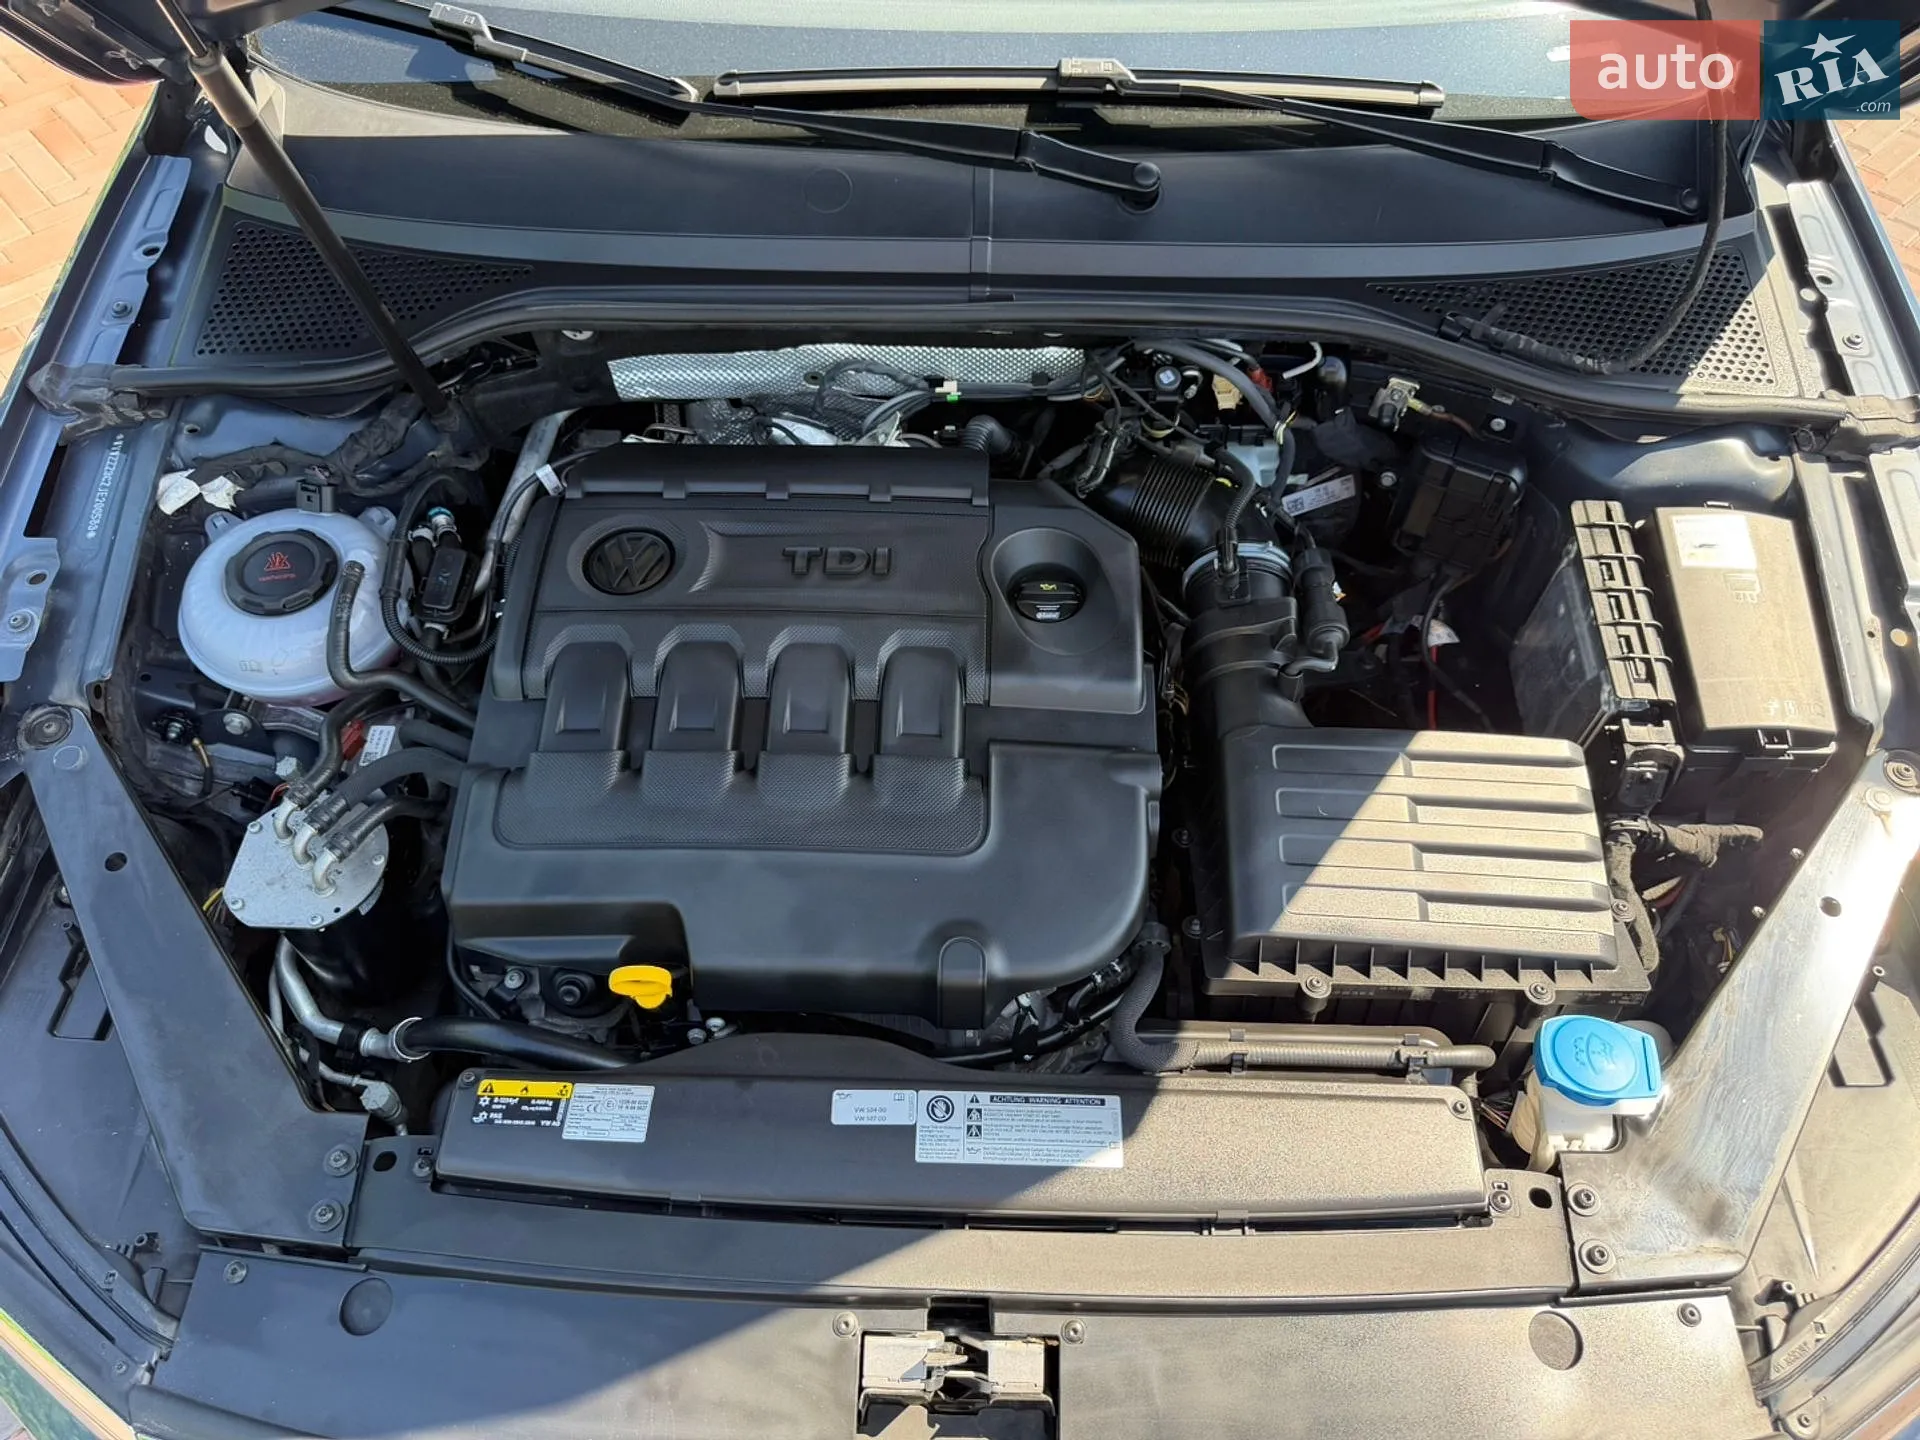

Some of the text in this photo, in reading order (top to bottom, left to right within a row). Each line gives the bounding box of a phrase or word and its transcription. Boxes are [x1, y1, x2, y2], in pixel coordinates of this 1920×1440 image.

[783, 547, 892, 575] TDI
[992, 1095, 1102, 1106] ACHTUNG WARNING ATTENTION
